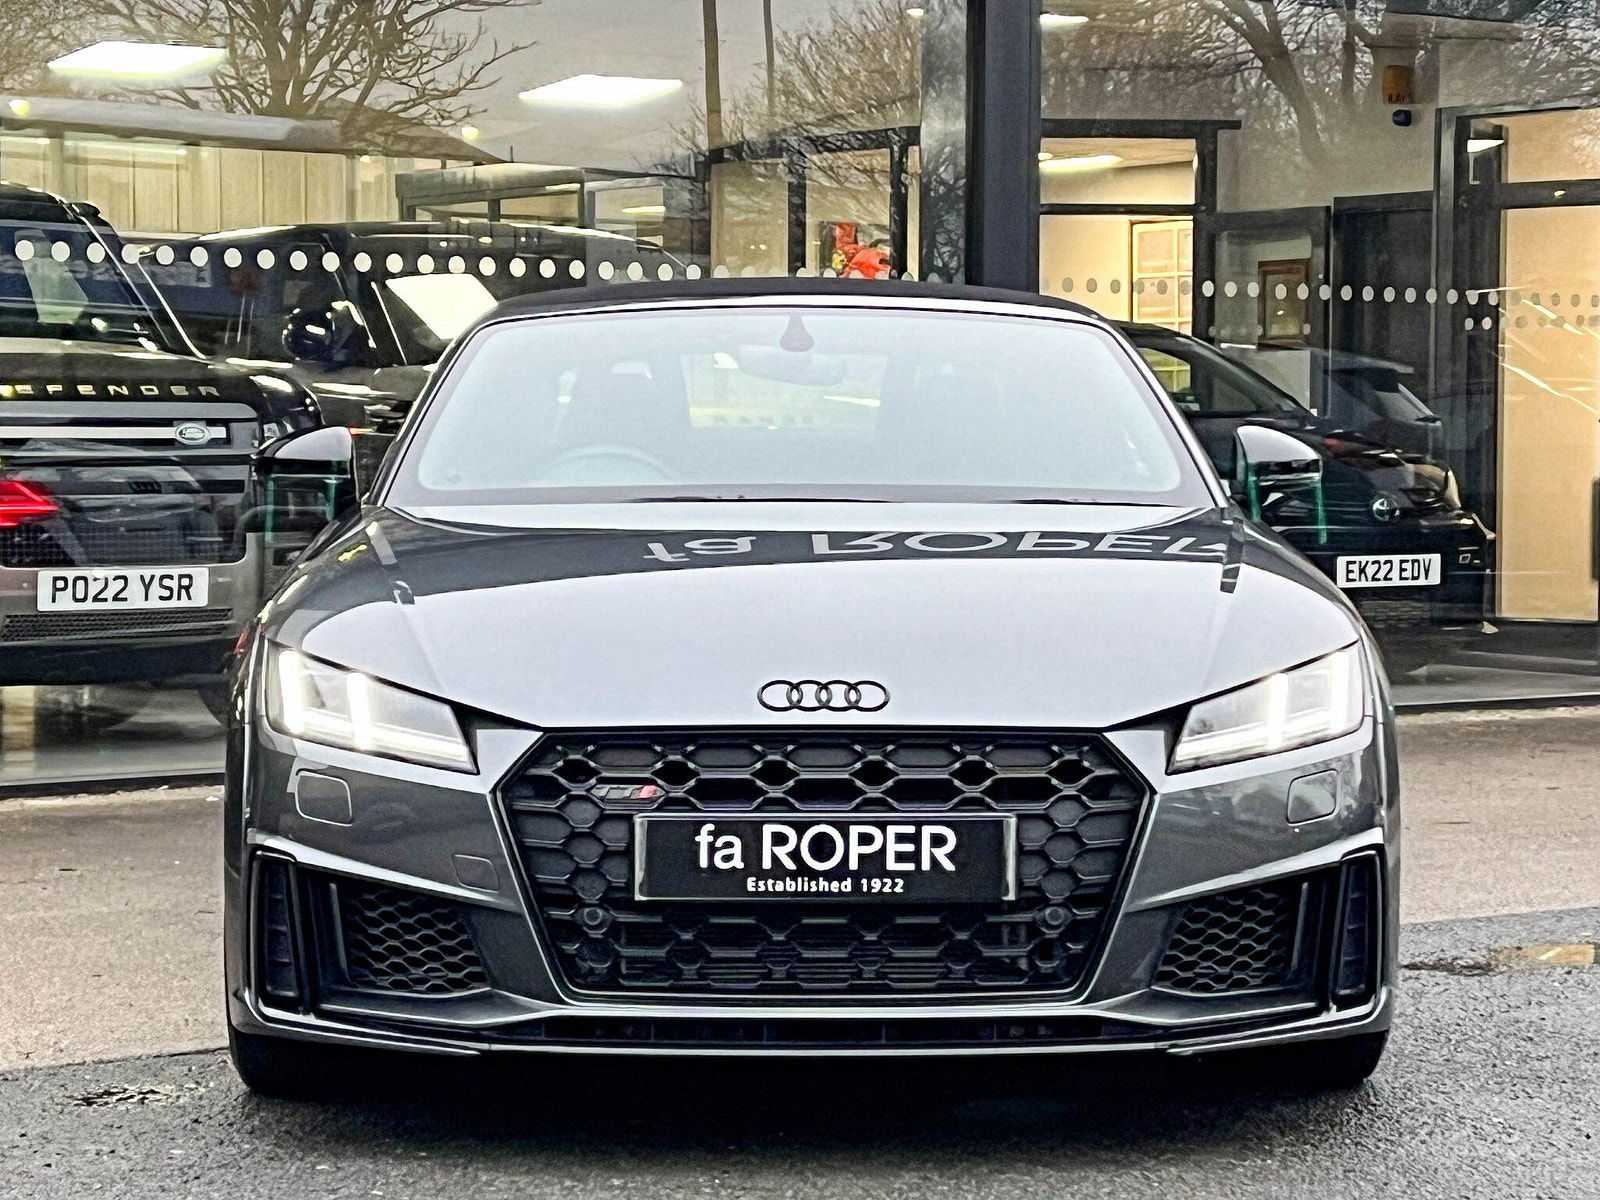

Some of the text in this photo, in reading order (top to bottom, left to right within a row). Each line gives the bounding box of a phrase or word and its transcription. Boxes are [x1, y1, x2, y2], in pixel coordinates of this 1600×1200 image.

[0, 384, 220, 397] EFENDER
[1345, 557, 1433, 583] EK22 EDV
[51, 573, 194, 604] PO22 YSR
[694, 823, 957, 872] fa ROPER
[746, 876, 904, 893] Established 1922
